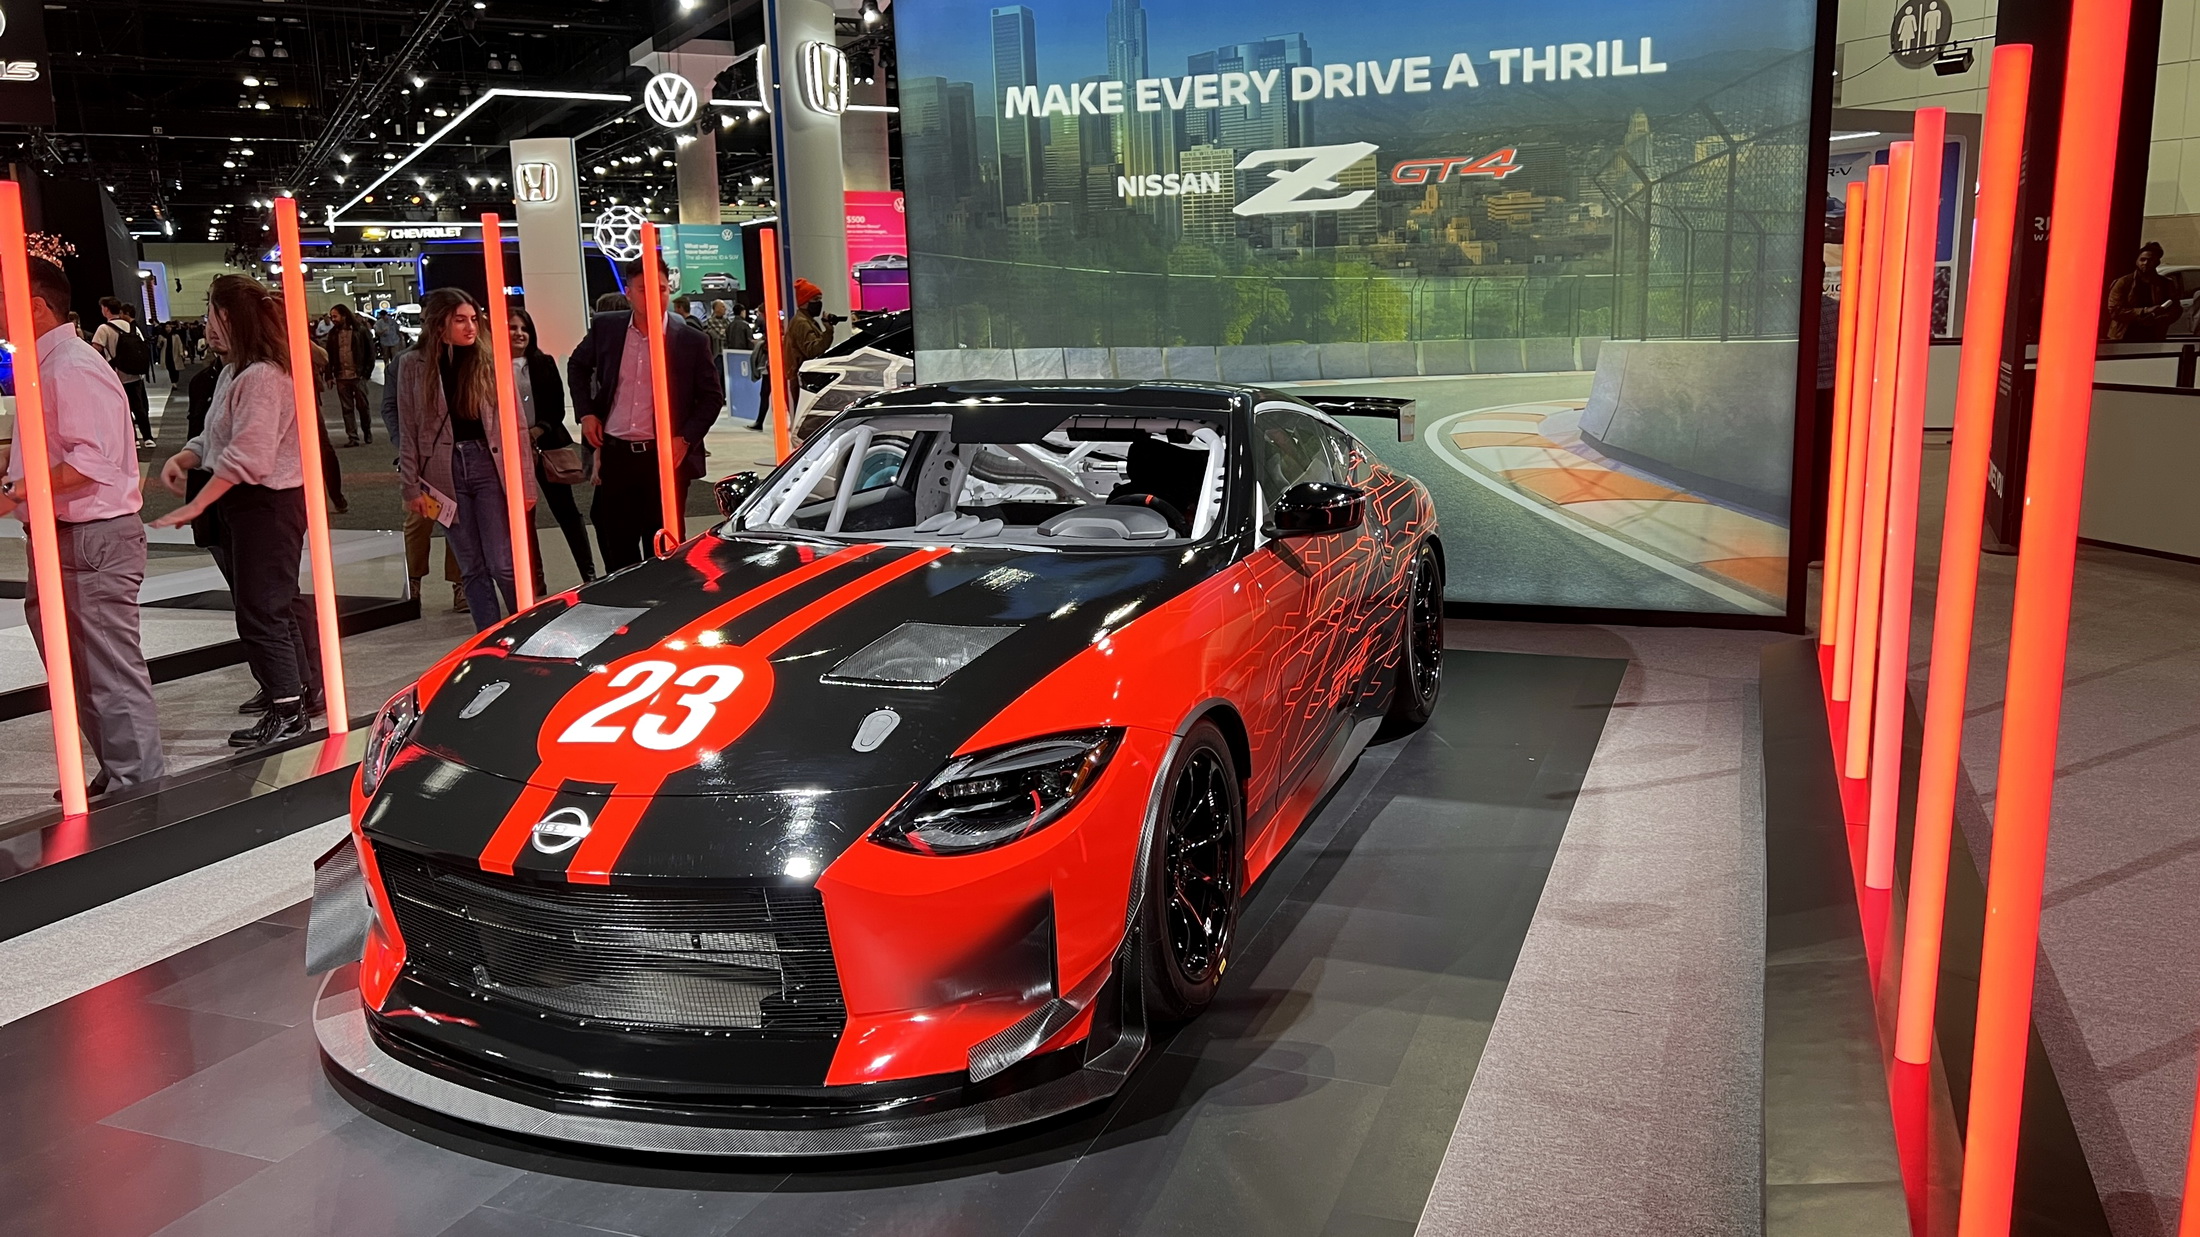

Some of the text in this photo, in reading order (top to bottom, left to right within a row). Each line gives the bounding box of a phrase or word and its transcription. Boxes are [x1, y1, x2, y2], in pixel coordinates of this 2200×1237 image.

[1005, 36, 1667, 119] MAKE EVERY DRIVE A THRILL
[1117, 141, 1523, 217] NISSAN Z GT4
[391, 227, 463, 239] CHEVROLET
[846, 215, 866, 224] $500
[557, 660, 744, 750] 23
